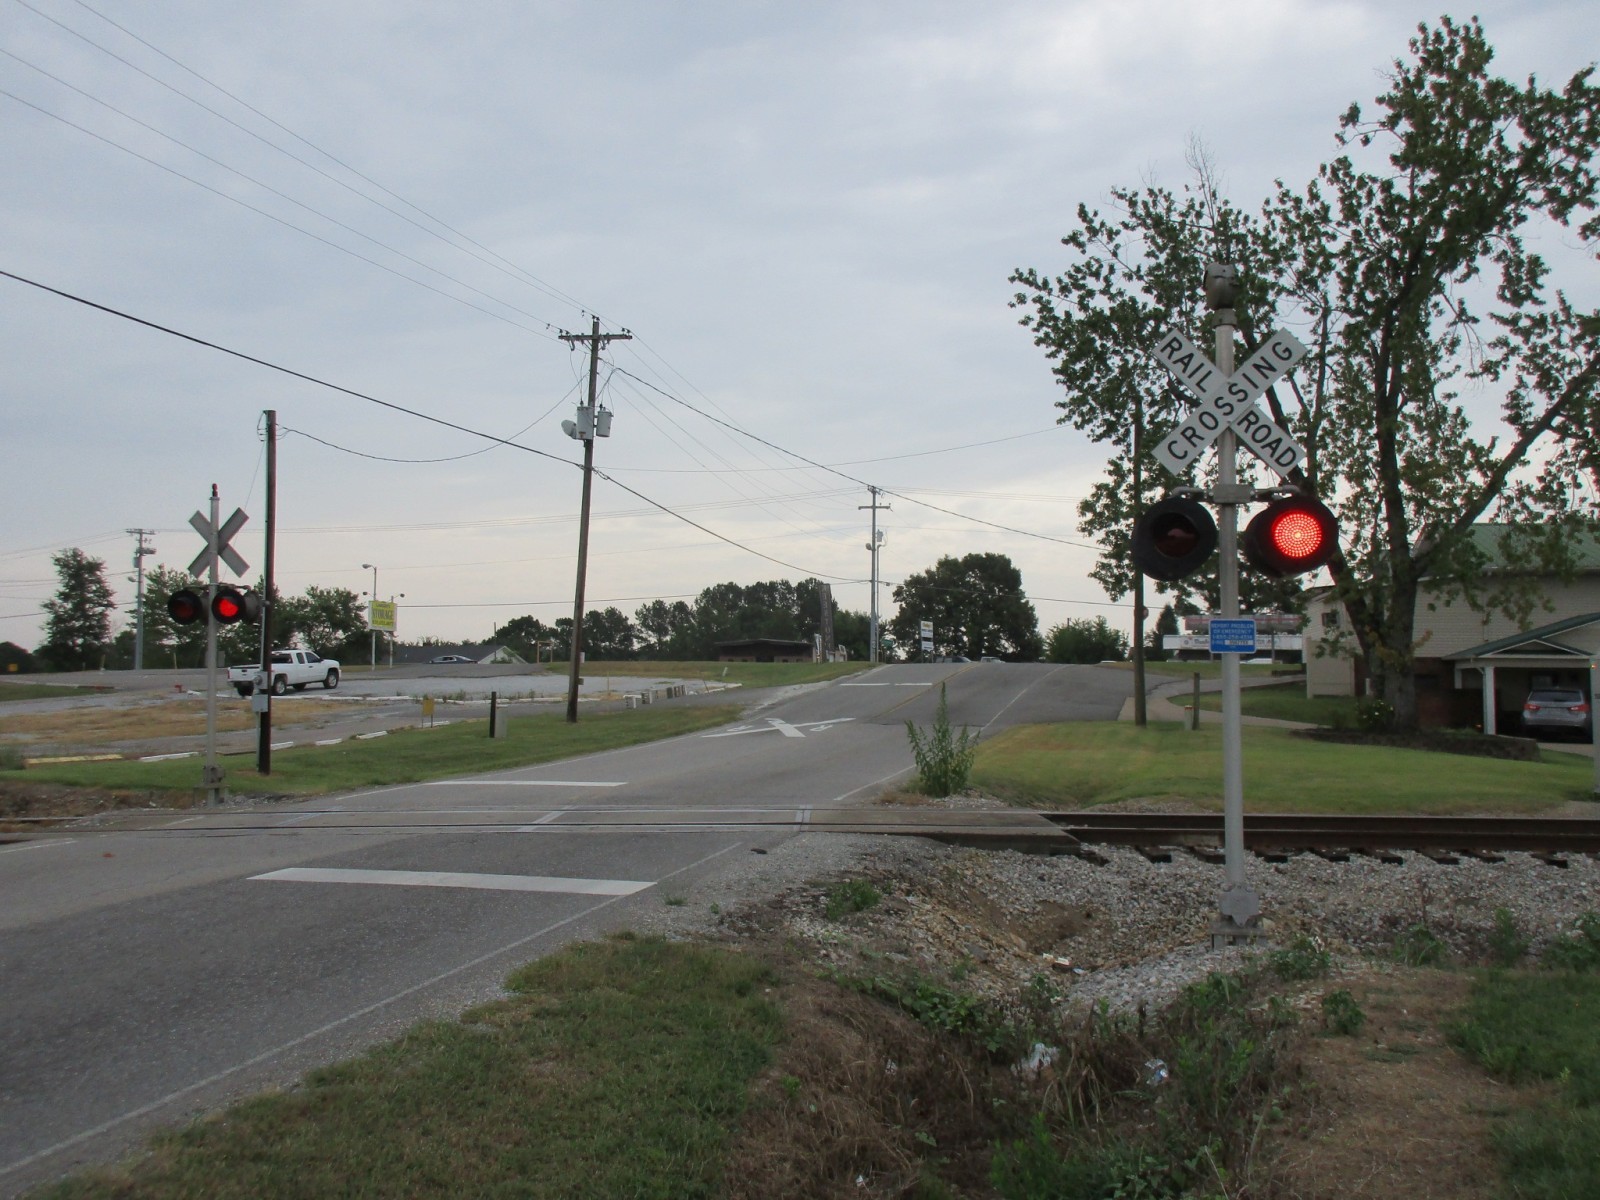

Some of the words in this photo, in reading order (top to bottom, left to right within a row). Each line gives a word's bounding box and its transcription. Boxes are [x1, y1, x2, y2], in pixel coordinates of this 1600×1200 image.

[1160, 336, 1213, 393] RAIL
[1237, 410, 1297, 467] ROAD
[1167, 341, 1293, 460] CROSSING
